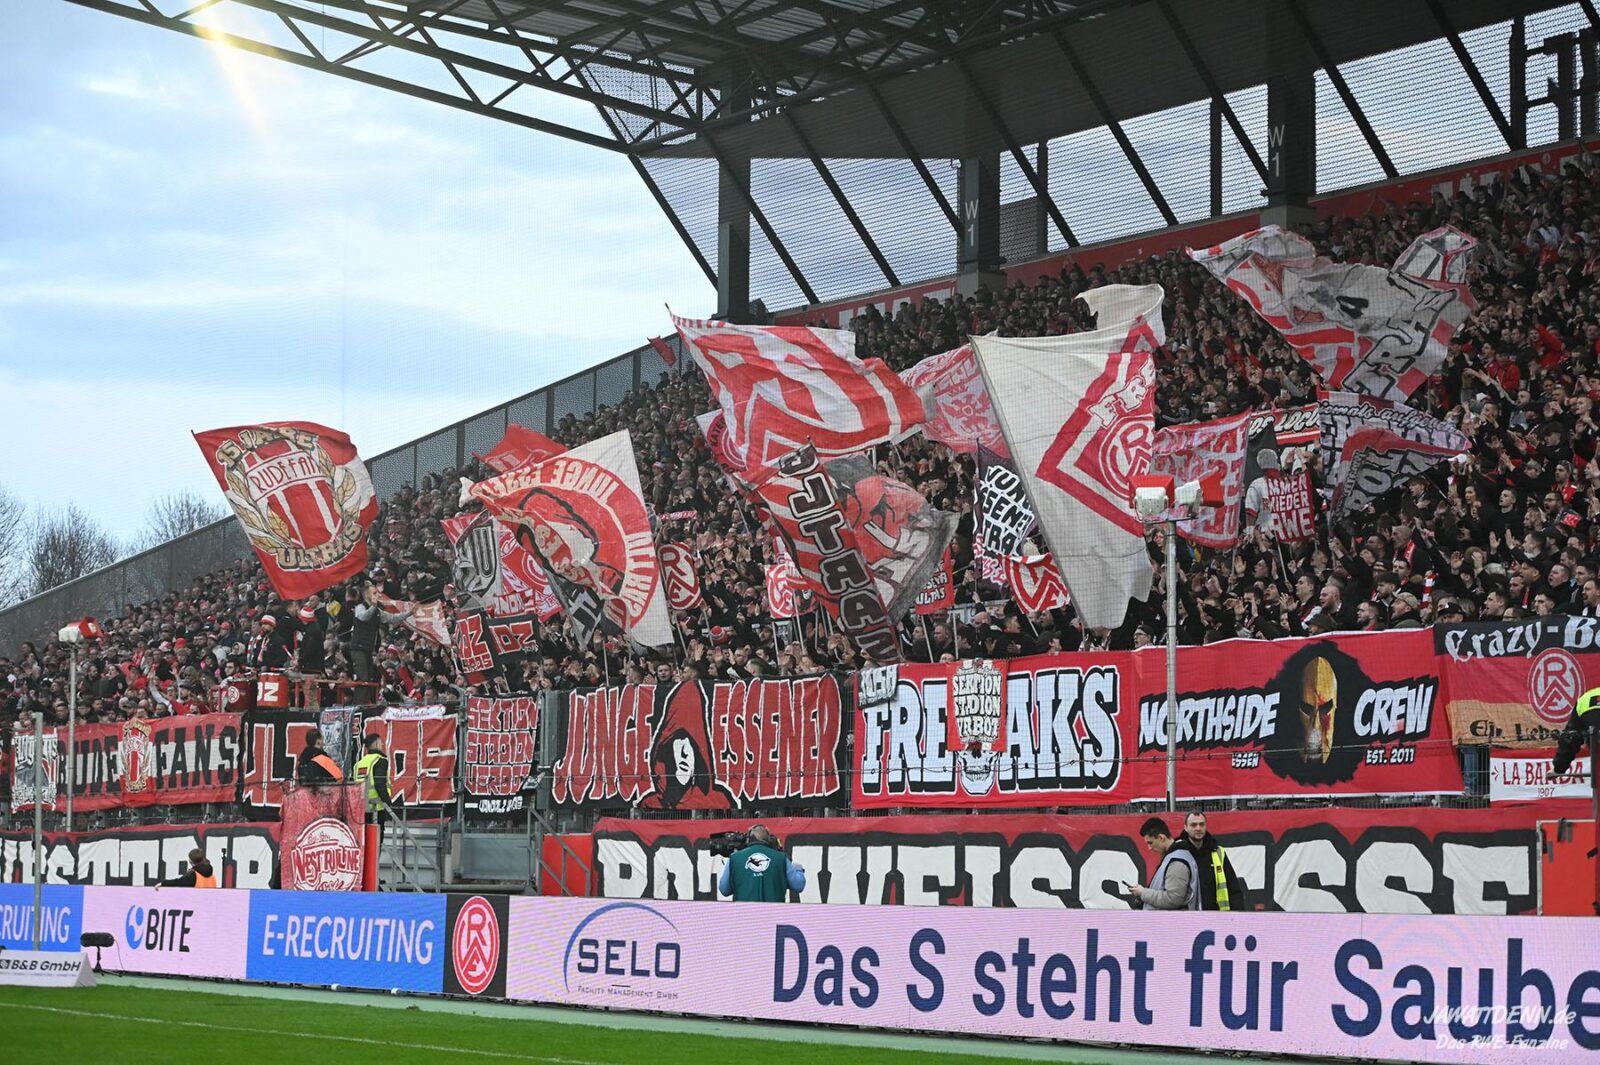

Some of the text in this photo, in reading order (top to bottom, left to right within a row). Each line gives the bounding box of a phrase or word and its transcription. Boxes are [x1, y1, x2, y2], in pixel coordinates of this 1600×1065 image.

[1268, 124, 1286, 147] W
[1272, 154, 1281, 177] 1
[965, 199, 979, 220] W
[968, 224, 975, 247] 1
[467, 697, 539, 731] SEKTION
[1138, 683, 1434, 747] NORTHSIDE CREW
[154, 723, 237, 790] FANS
[466, 729, 536, 764] STADION
[552, 673, 841, 804] JUNGE ESSENER
[1502, 761, 1520, 786] LA
[0, 904, 71, 944] RUIING
[145, 908, 194, 953] BITE
[263, 913, 434, 966] E-RECRUITING
[11, 959, 82, 972] B&B GmbH
[577, 938, 681, 980] SELO
[774, 923, 880, 1009] Das
[906, 927, 946, 1013] S
[972, 927, 1155, 1026] steht
[1185, 929, 1299, 1032] für
